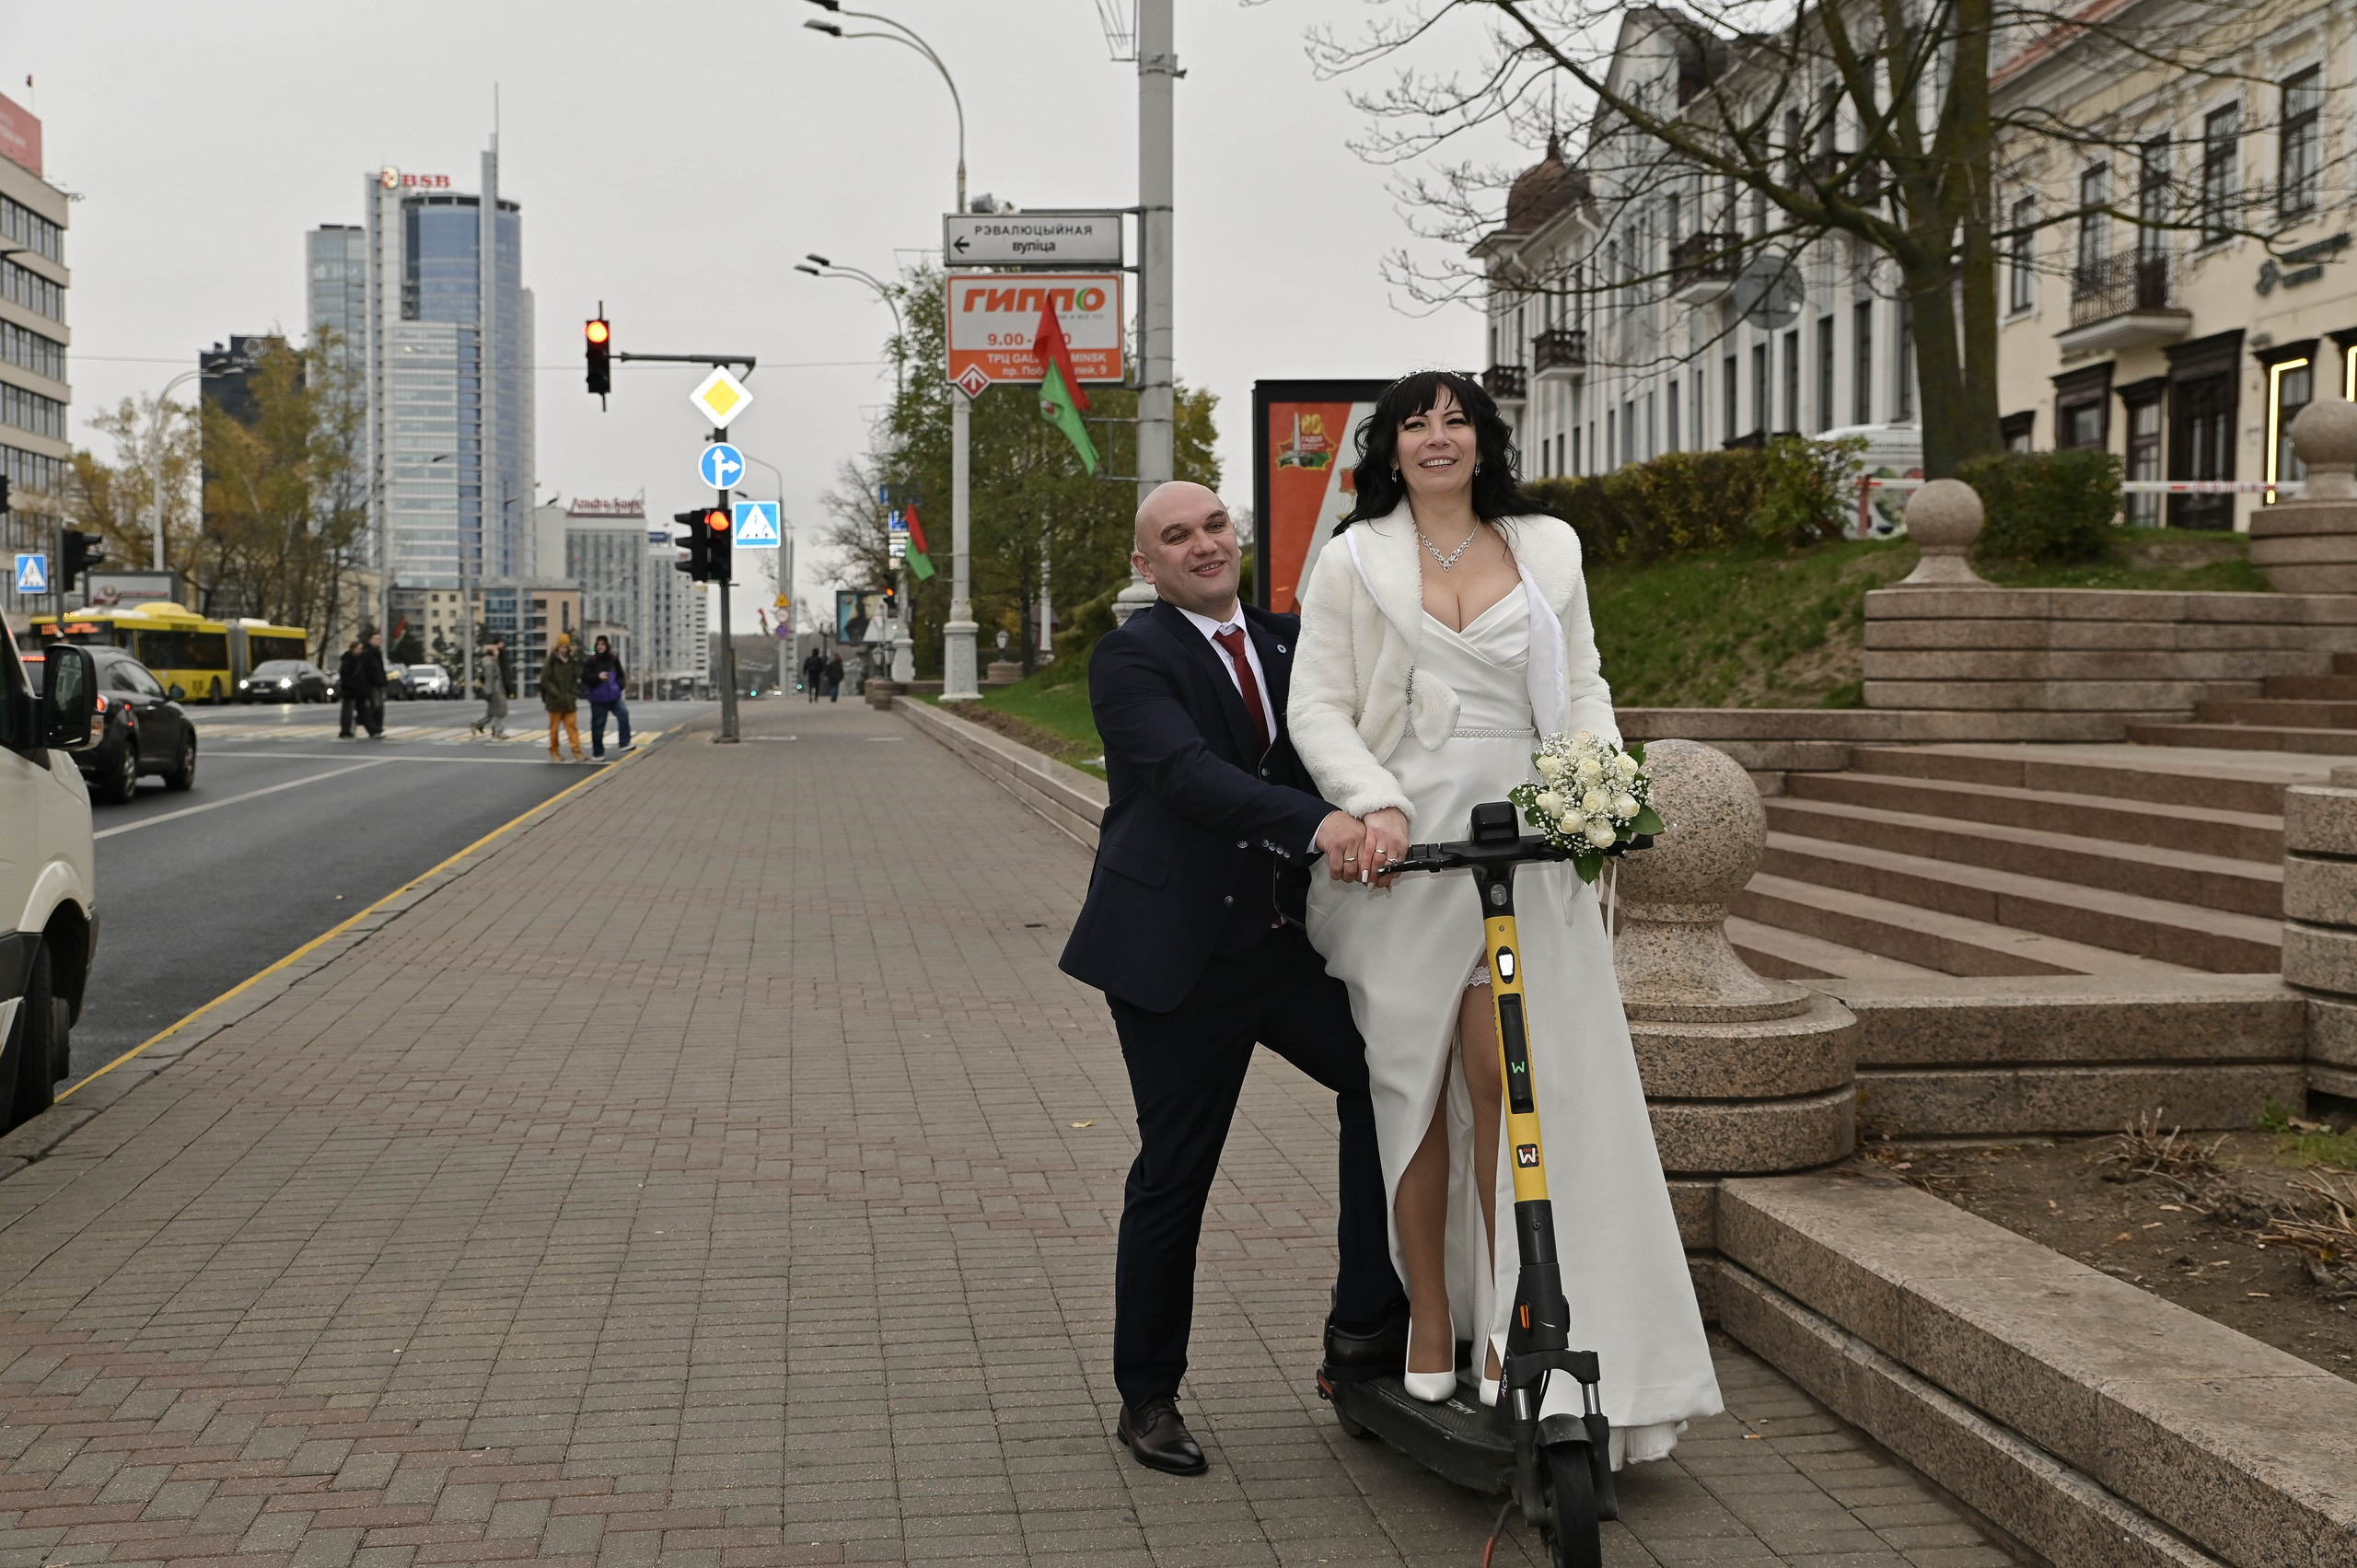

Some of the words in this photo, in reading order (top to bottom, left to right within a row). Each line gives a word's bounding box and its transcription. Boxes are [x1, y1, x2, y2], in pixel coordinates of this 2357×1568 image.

[402, 174, 450, 188] BSB
[974, 224, 1093, 237] РЭВАЛЮЦЫЙНАЯ
[1012, 239, 1056, 254] вуліца
[963, 287, 1107, 312] ГИППО
[1511, 1061, 1525, 1074] W
[1518, 1147, 1537, 1164] W
